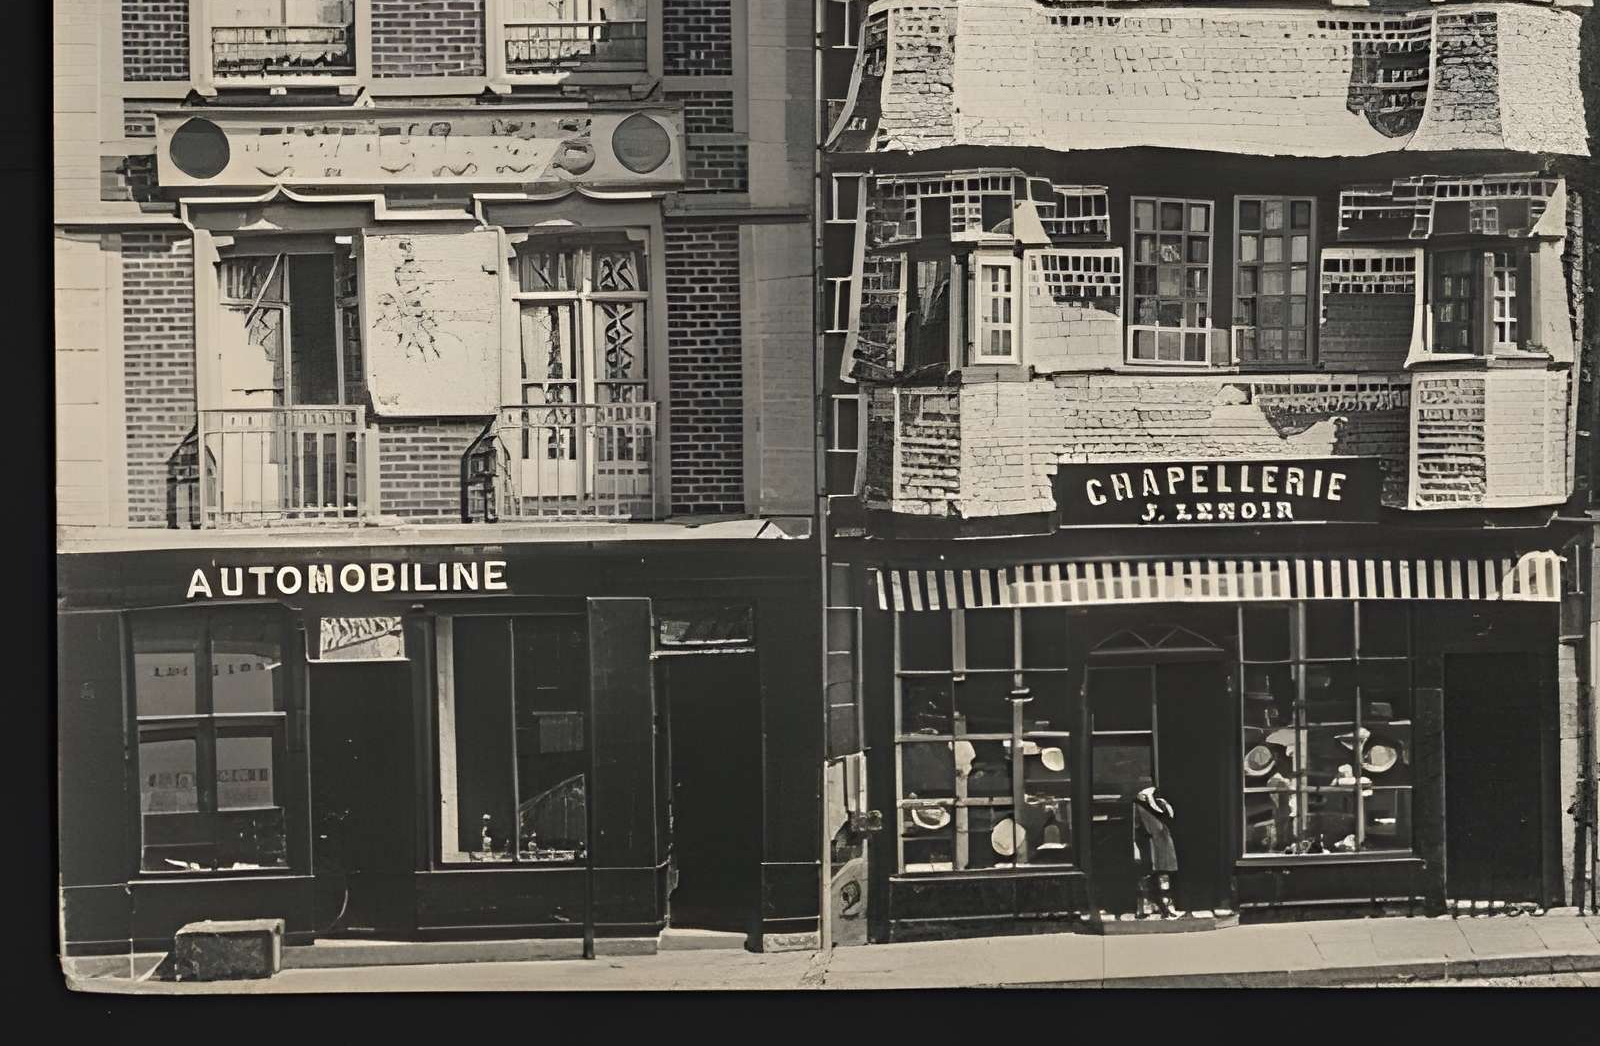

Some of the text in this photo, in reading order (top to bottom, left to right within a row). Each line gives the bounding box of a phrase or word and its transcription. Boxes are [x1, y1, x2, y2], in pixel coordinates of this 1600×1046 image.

[1086, 464, 1347, 506] CHAPELLERIE
[1176, 501, 1294, 522] LENOIR
[186, 560, 508, 598] AUTOMOBILINE
